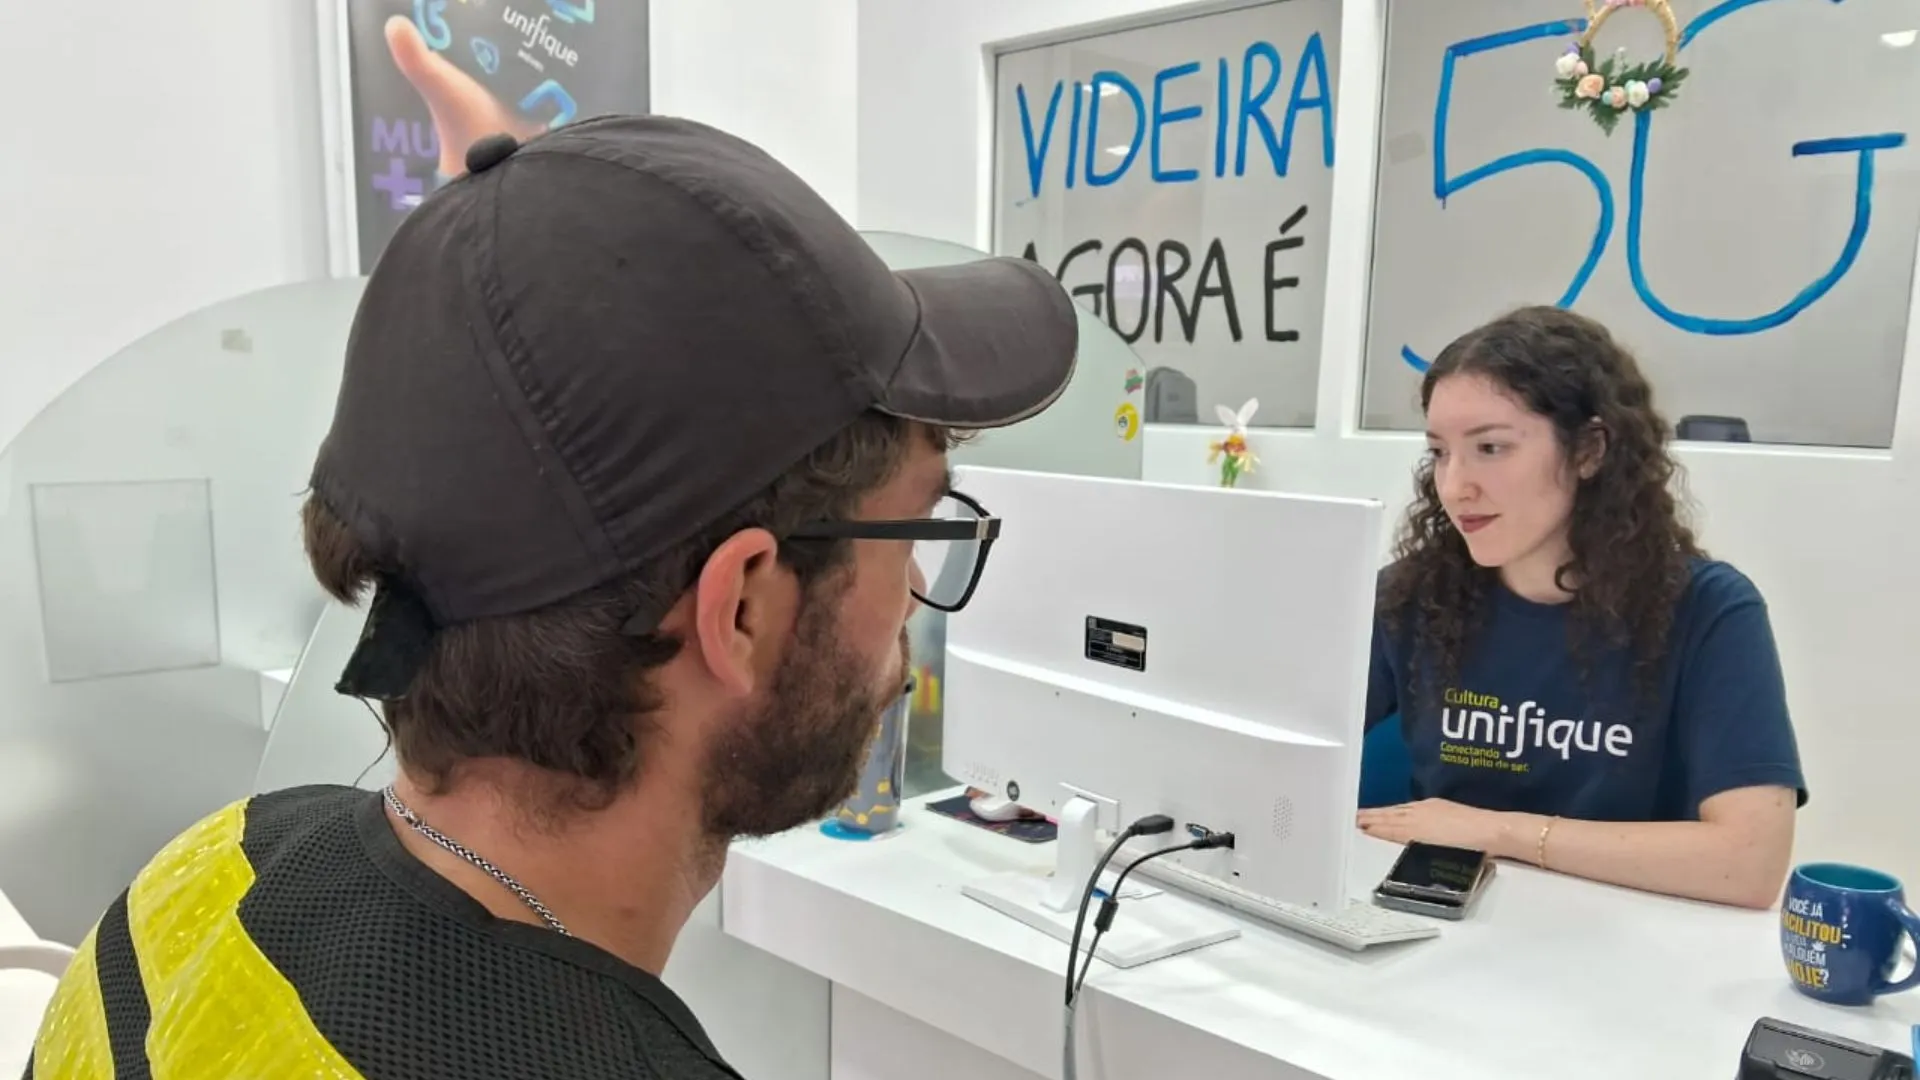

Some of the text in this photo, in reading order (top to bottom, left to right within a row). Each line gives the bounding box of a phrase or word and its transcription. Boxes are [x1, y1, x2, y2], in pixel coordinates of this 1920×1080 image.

[503, 5, 578, 68] unifique
[1016, 31, 1335, 198] VIDEIRA
[1402, 0, 1907, 373] 5G
[1023, 205, 1307, 345] GORA É
[1444, 687, 1499, 709] Cultura
[1440, 741, 1500, 759] Conectando
[1440, 753, 1469, 765] nosso
[1441, 701, 1633, 760] unifique
